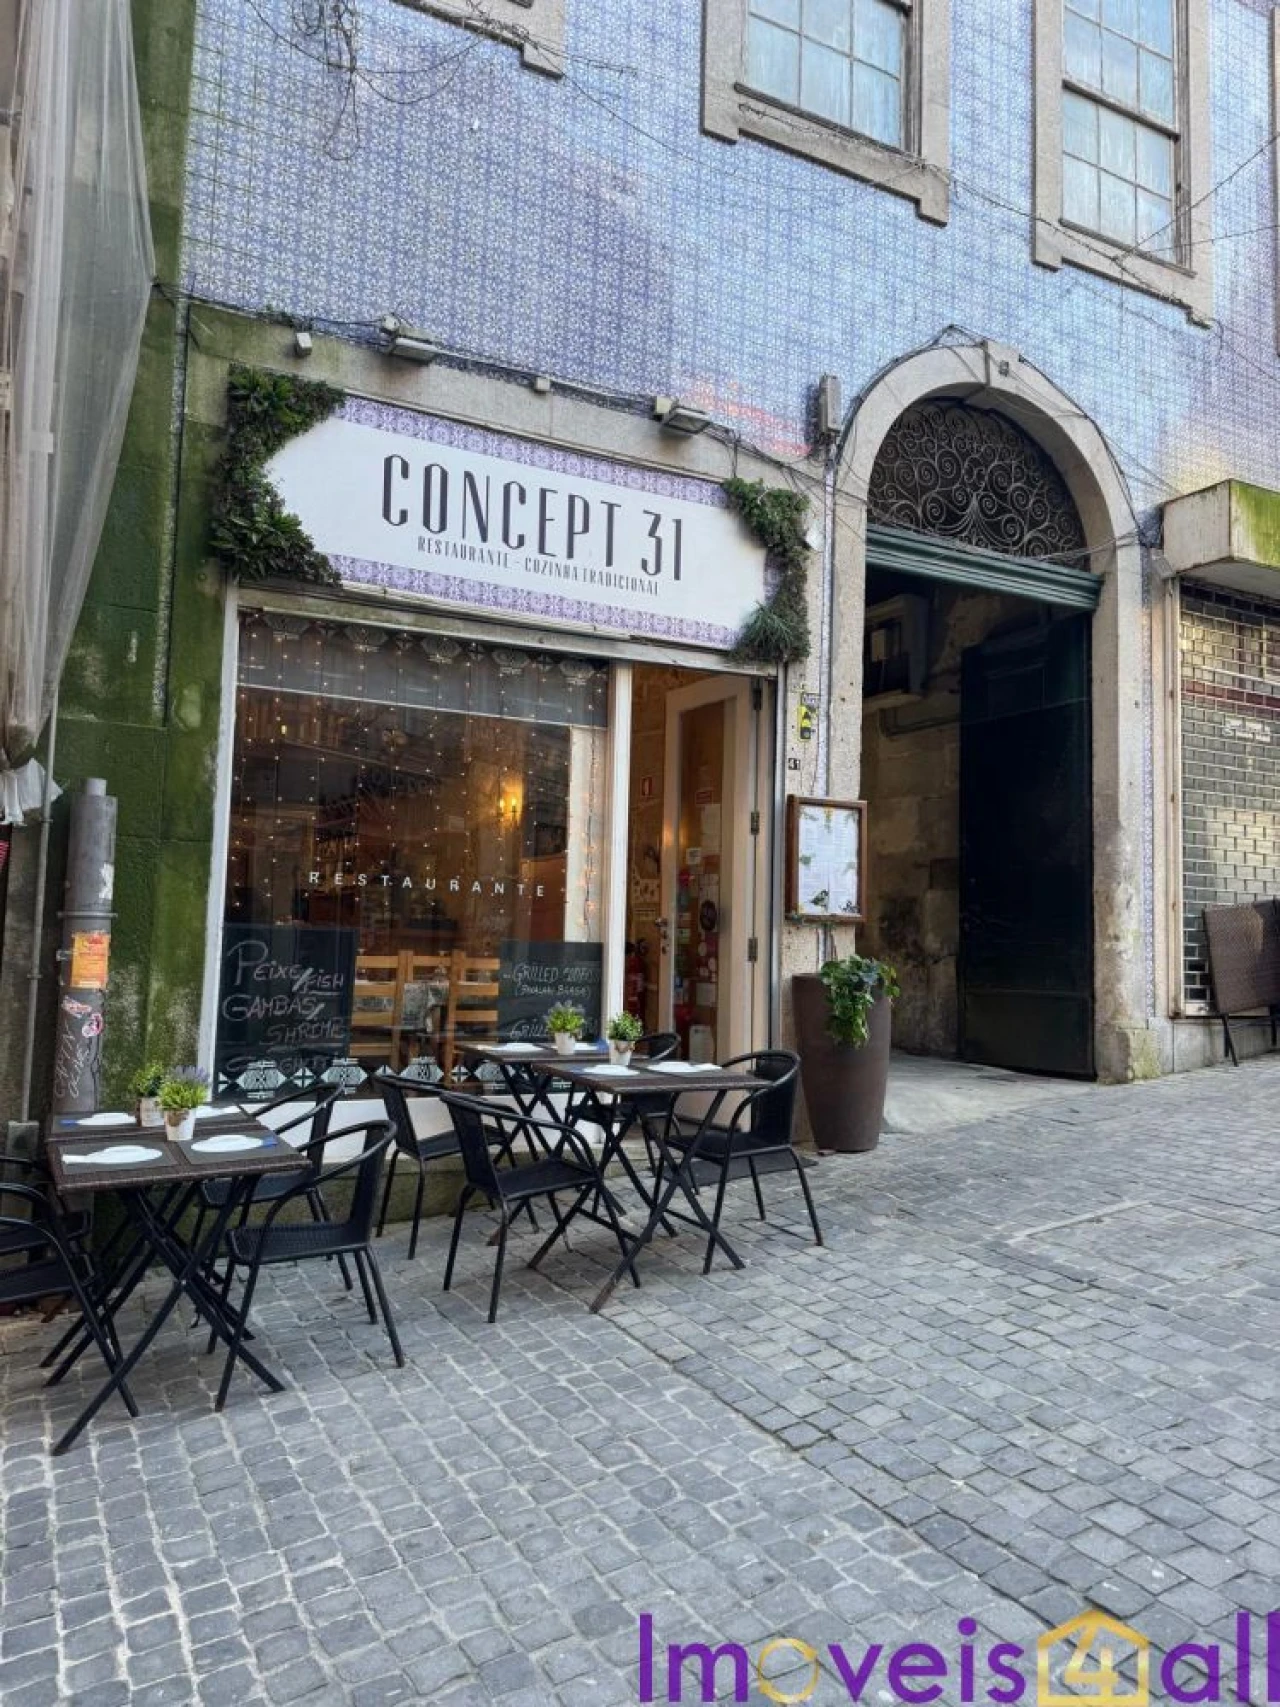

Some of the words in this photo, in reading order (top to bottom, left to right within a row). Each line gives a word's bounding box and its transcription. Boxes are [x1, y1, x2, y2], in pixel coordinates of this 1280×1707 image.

[382, 453, 622, 567] CONCEPT
[641, 509, 682, 581] 31
[418, 536, 513, 568] RESTAURANTE
[525, 557, 578, 580] COZINHA
[583, 567, 658, 596] TRADICIONAL
[308, 871, 544, 897] RESTAURANTE
